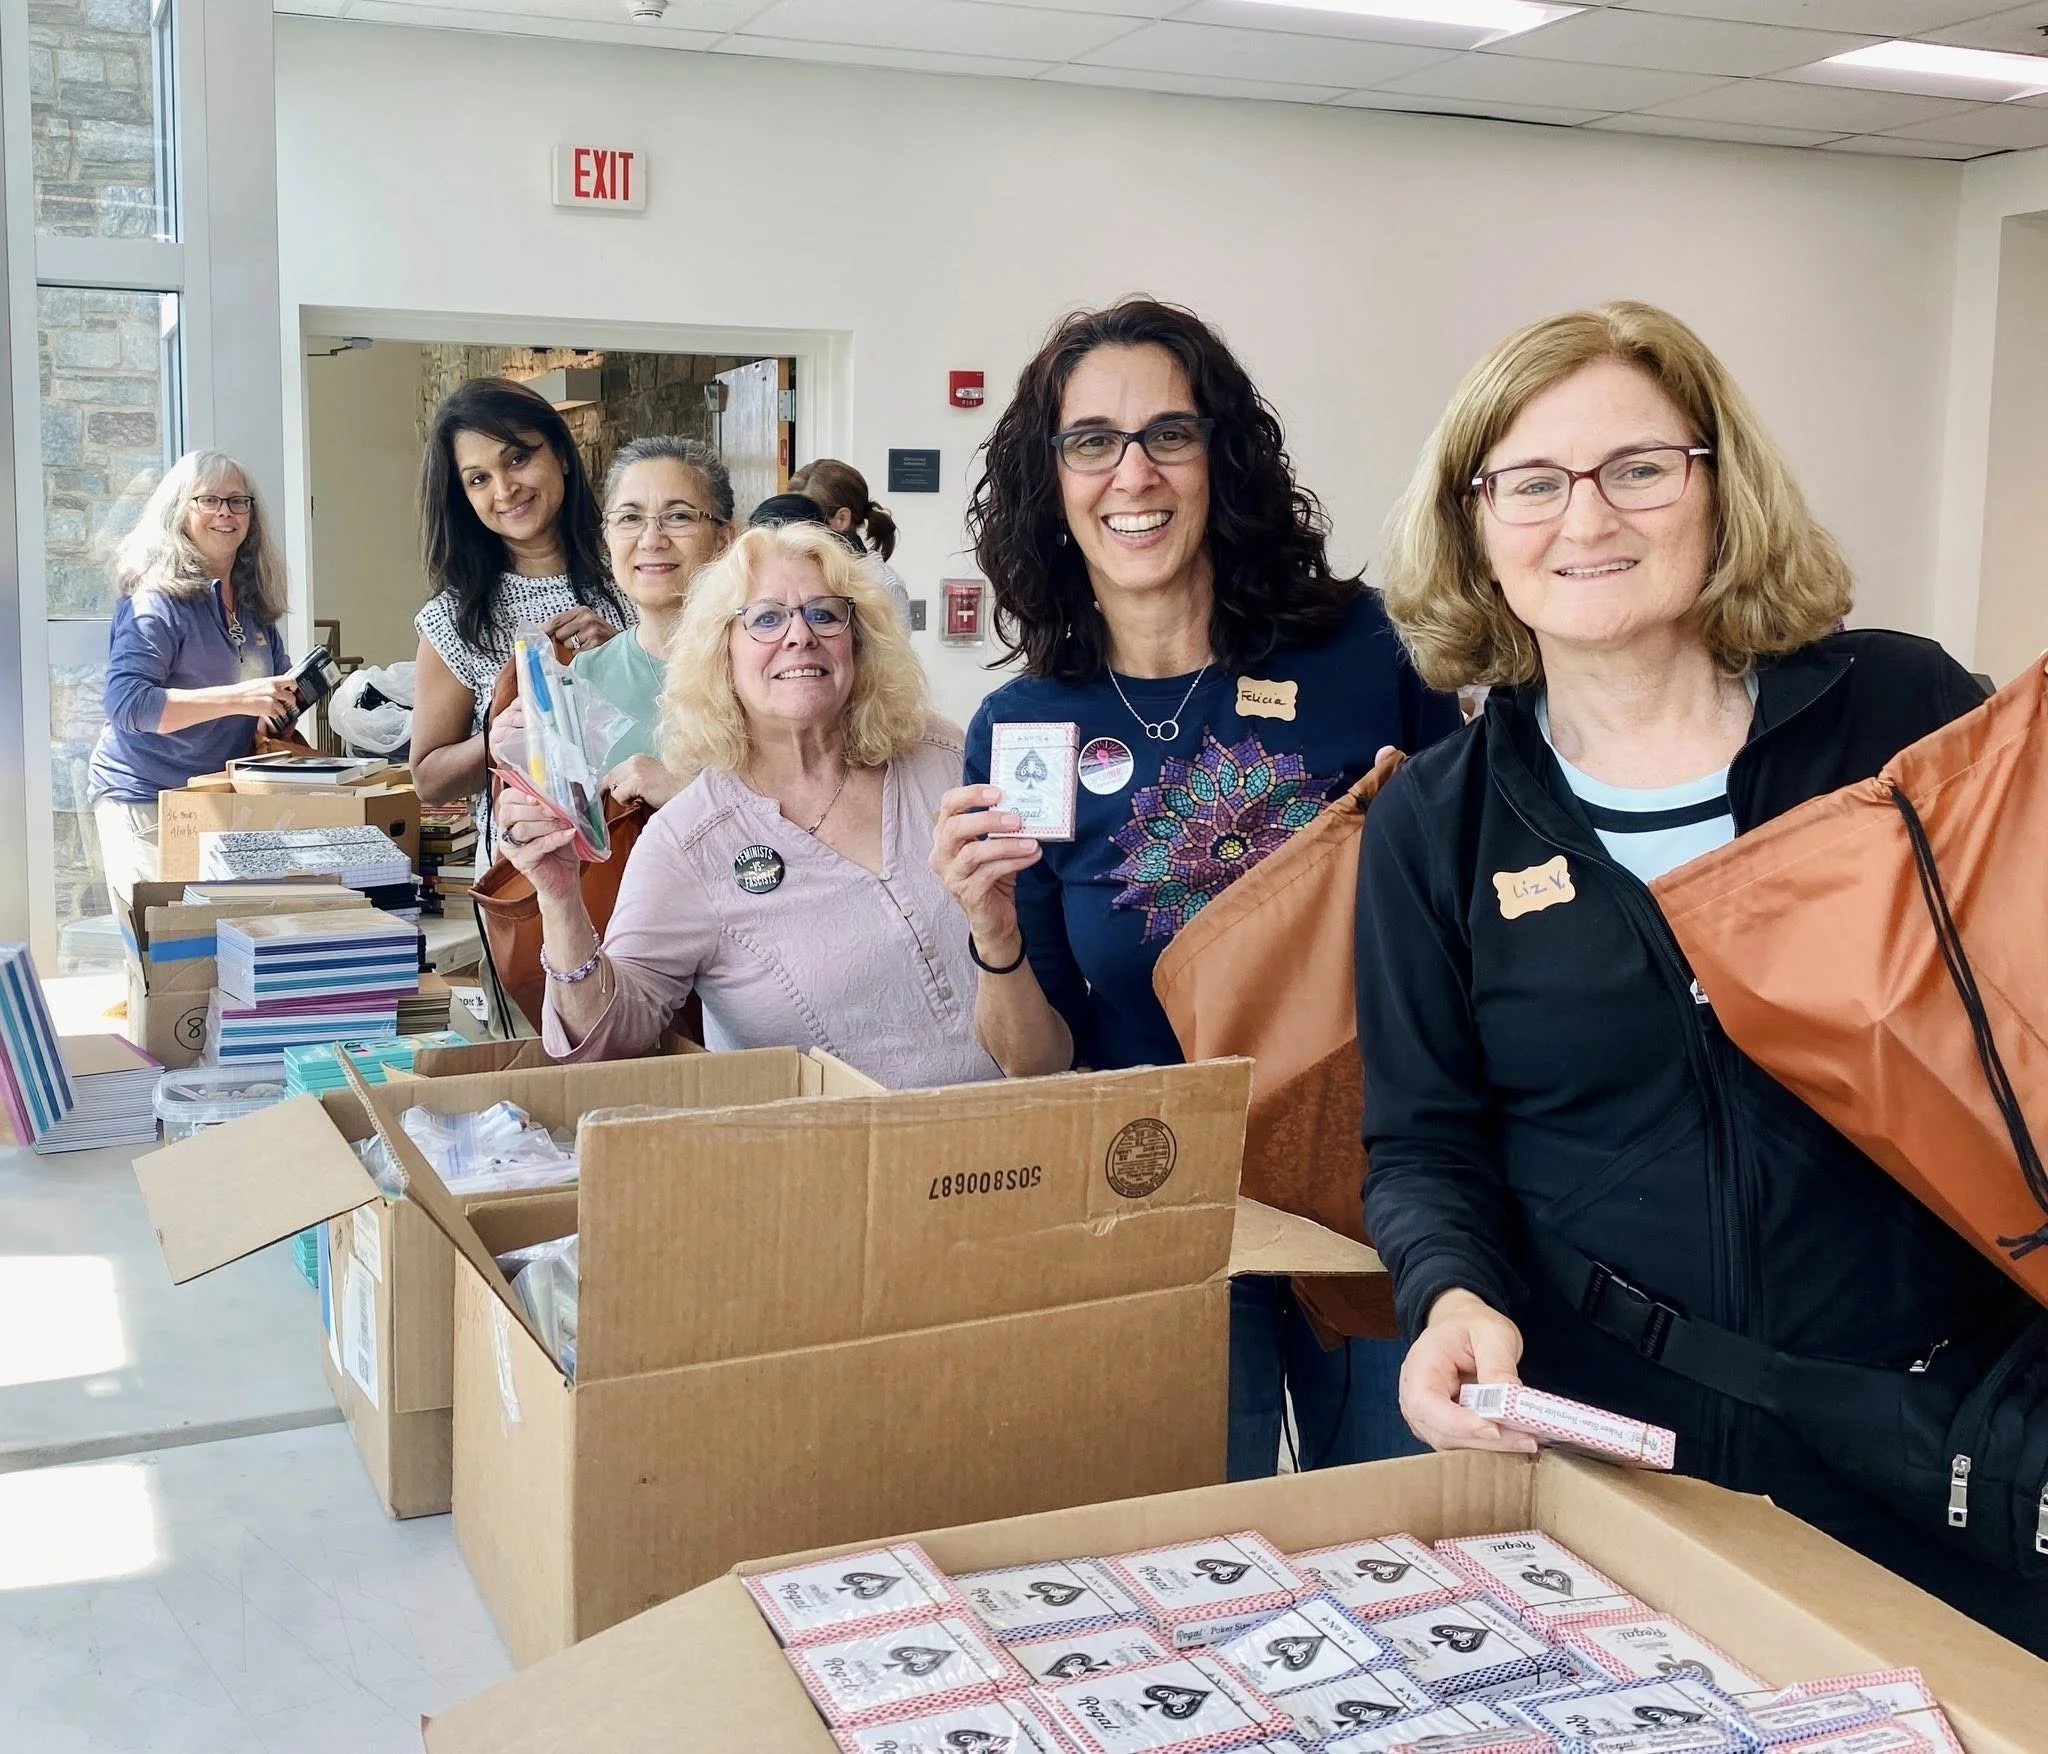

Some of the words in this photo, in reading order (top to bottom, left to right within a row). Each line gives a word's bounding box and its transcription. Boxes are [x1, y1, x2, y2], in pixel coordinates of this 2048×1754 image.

[574, 148, 634, 201] EXIT
[1241, 690, 1288, 706] Felicia
[735, 846, 774, 866] FEMINISTS
[187, 1017, 204, 1039] 8
[1490, 1539, 1536, 1553] Regal
[1139, 1565, 1175, 1591] Regal
[778, 1582, 815, 1610] Regal
[970, 1587, 1005, 1612] Regal
[1176, 1629, 1203, 1642] Regal
[1211, 1626, 1234, 1635] Poker
[1618, 1626, 1667, 1640] Regal
[1077, 1695, 1121, 1730] Regal
[1565, 1714, 1597, 1736] Reg
